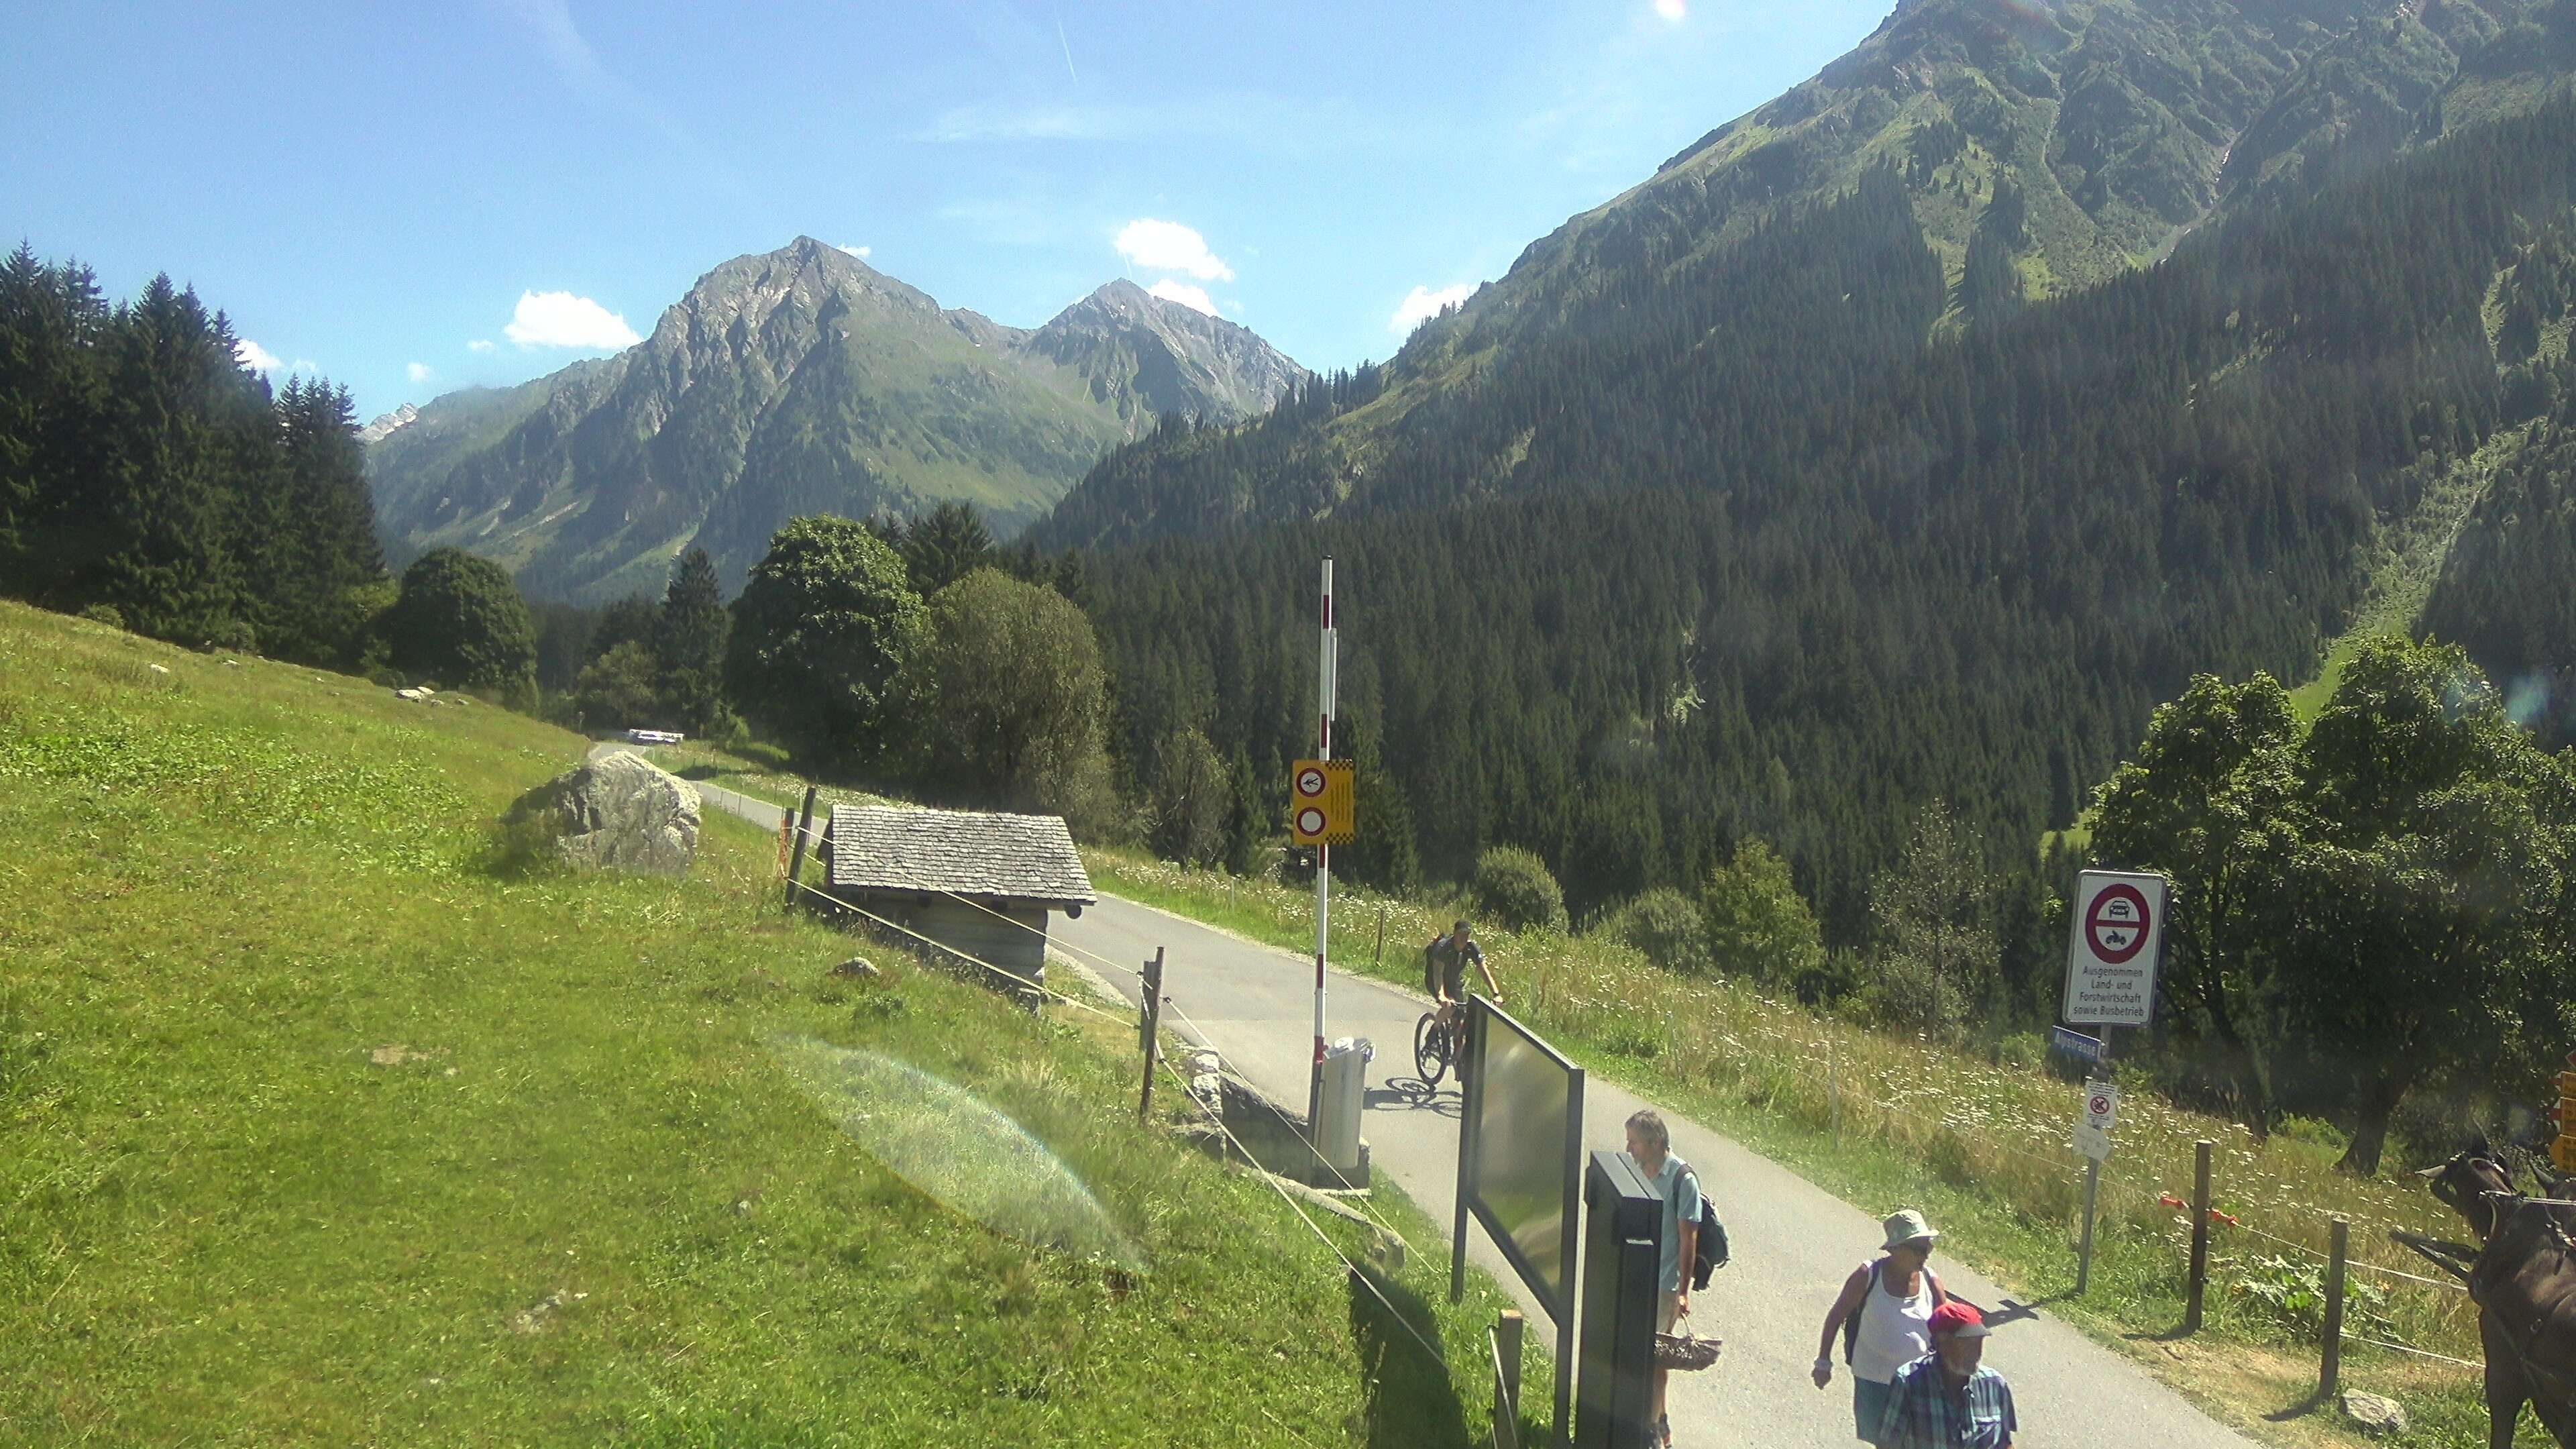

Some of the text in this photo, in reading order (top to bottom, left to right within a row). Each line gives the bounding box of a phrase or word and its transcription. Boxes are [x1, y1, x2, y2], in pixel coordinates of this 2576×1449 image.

[2083, 966, 2143, 978] Ausgenommen
[2091, 979, 2133, 989] Land- und
[2080, 991, 2141, 1003] Forstwirtschaft
[2074, 1006, 2144, 1016] sowie Busbetrieb
